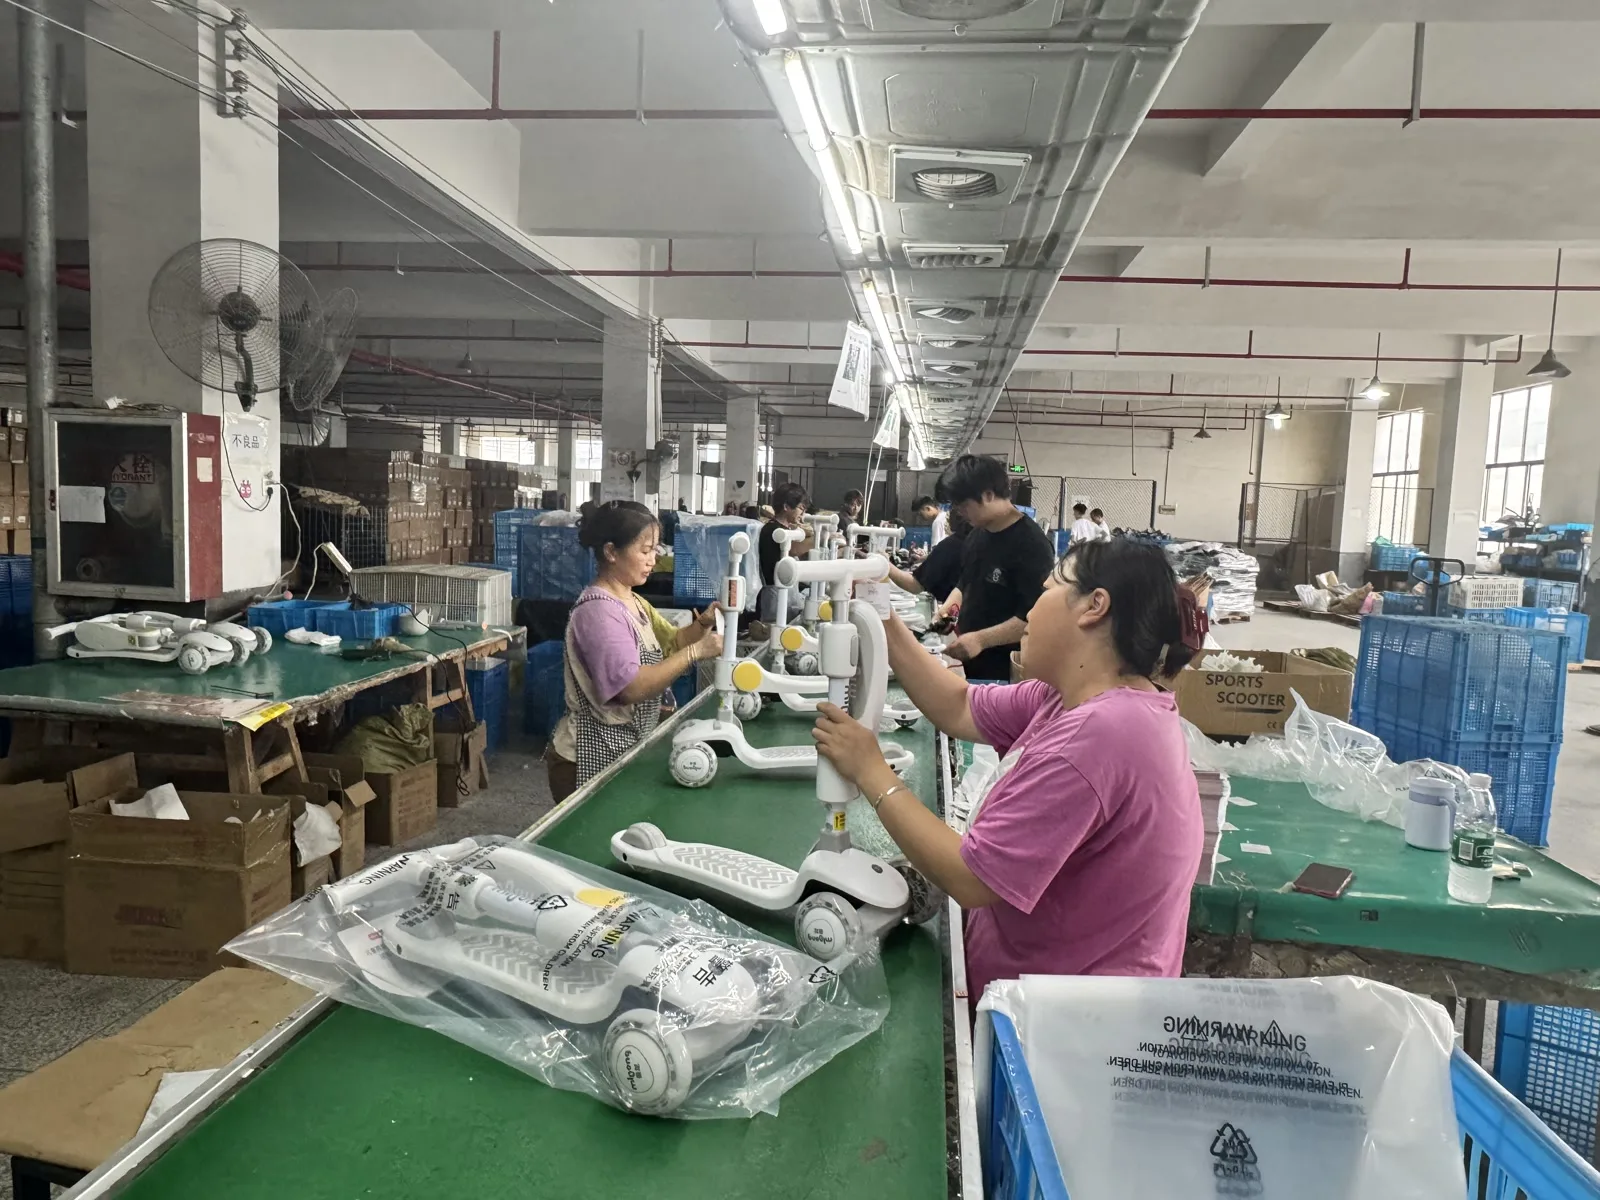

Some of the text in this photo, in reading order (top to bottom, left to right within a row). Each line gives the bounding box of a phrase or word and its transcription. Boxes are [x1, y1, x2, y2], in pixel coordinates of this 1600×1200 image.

[231, 434, 260, 449] 不良品
[1205, 673, 1264, 689] SPORTS
[1216, 691, 1286, 707] SCOOTER
[591, 911, 641, 959] WARNING
